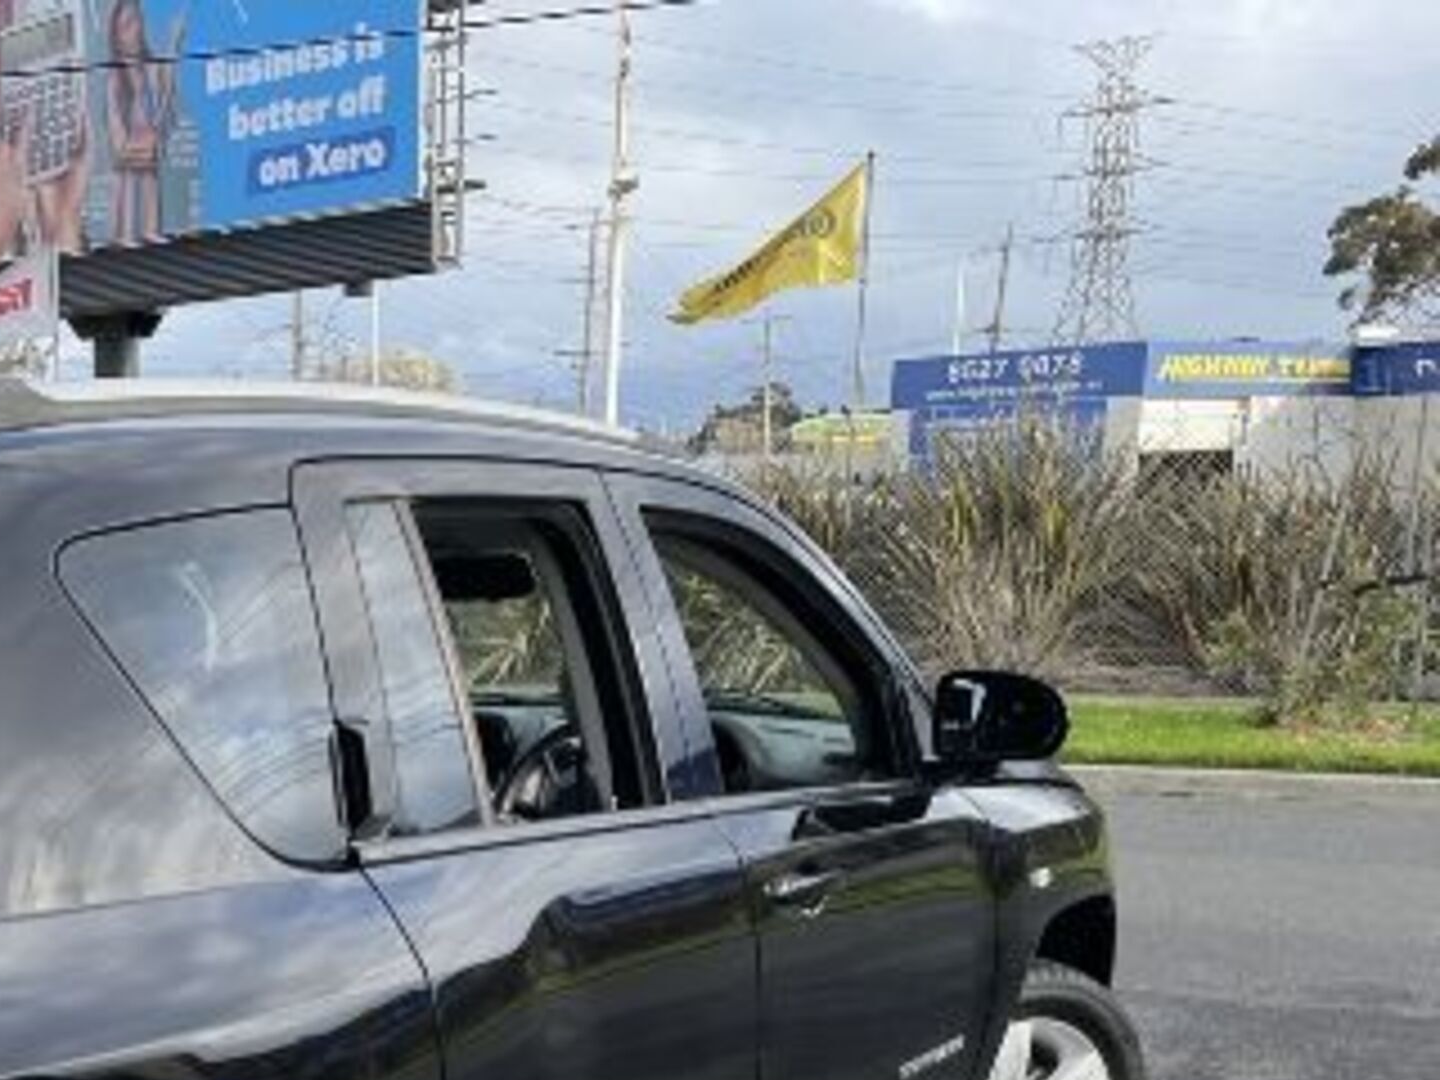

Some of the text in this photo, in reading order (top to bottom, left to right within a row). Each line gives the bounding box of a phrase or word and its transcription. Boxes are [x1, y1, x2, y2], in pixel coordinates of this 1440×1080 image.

[206, 21, 383, 94] Business is
[229, 74, 384, 140] better off
[260, 138, 384, 186] on Xero
